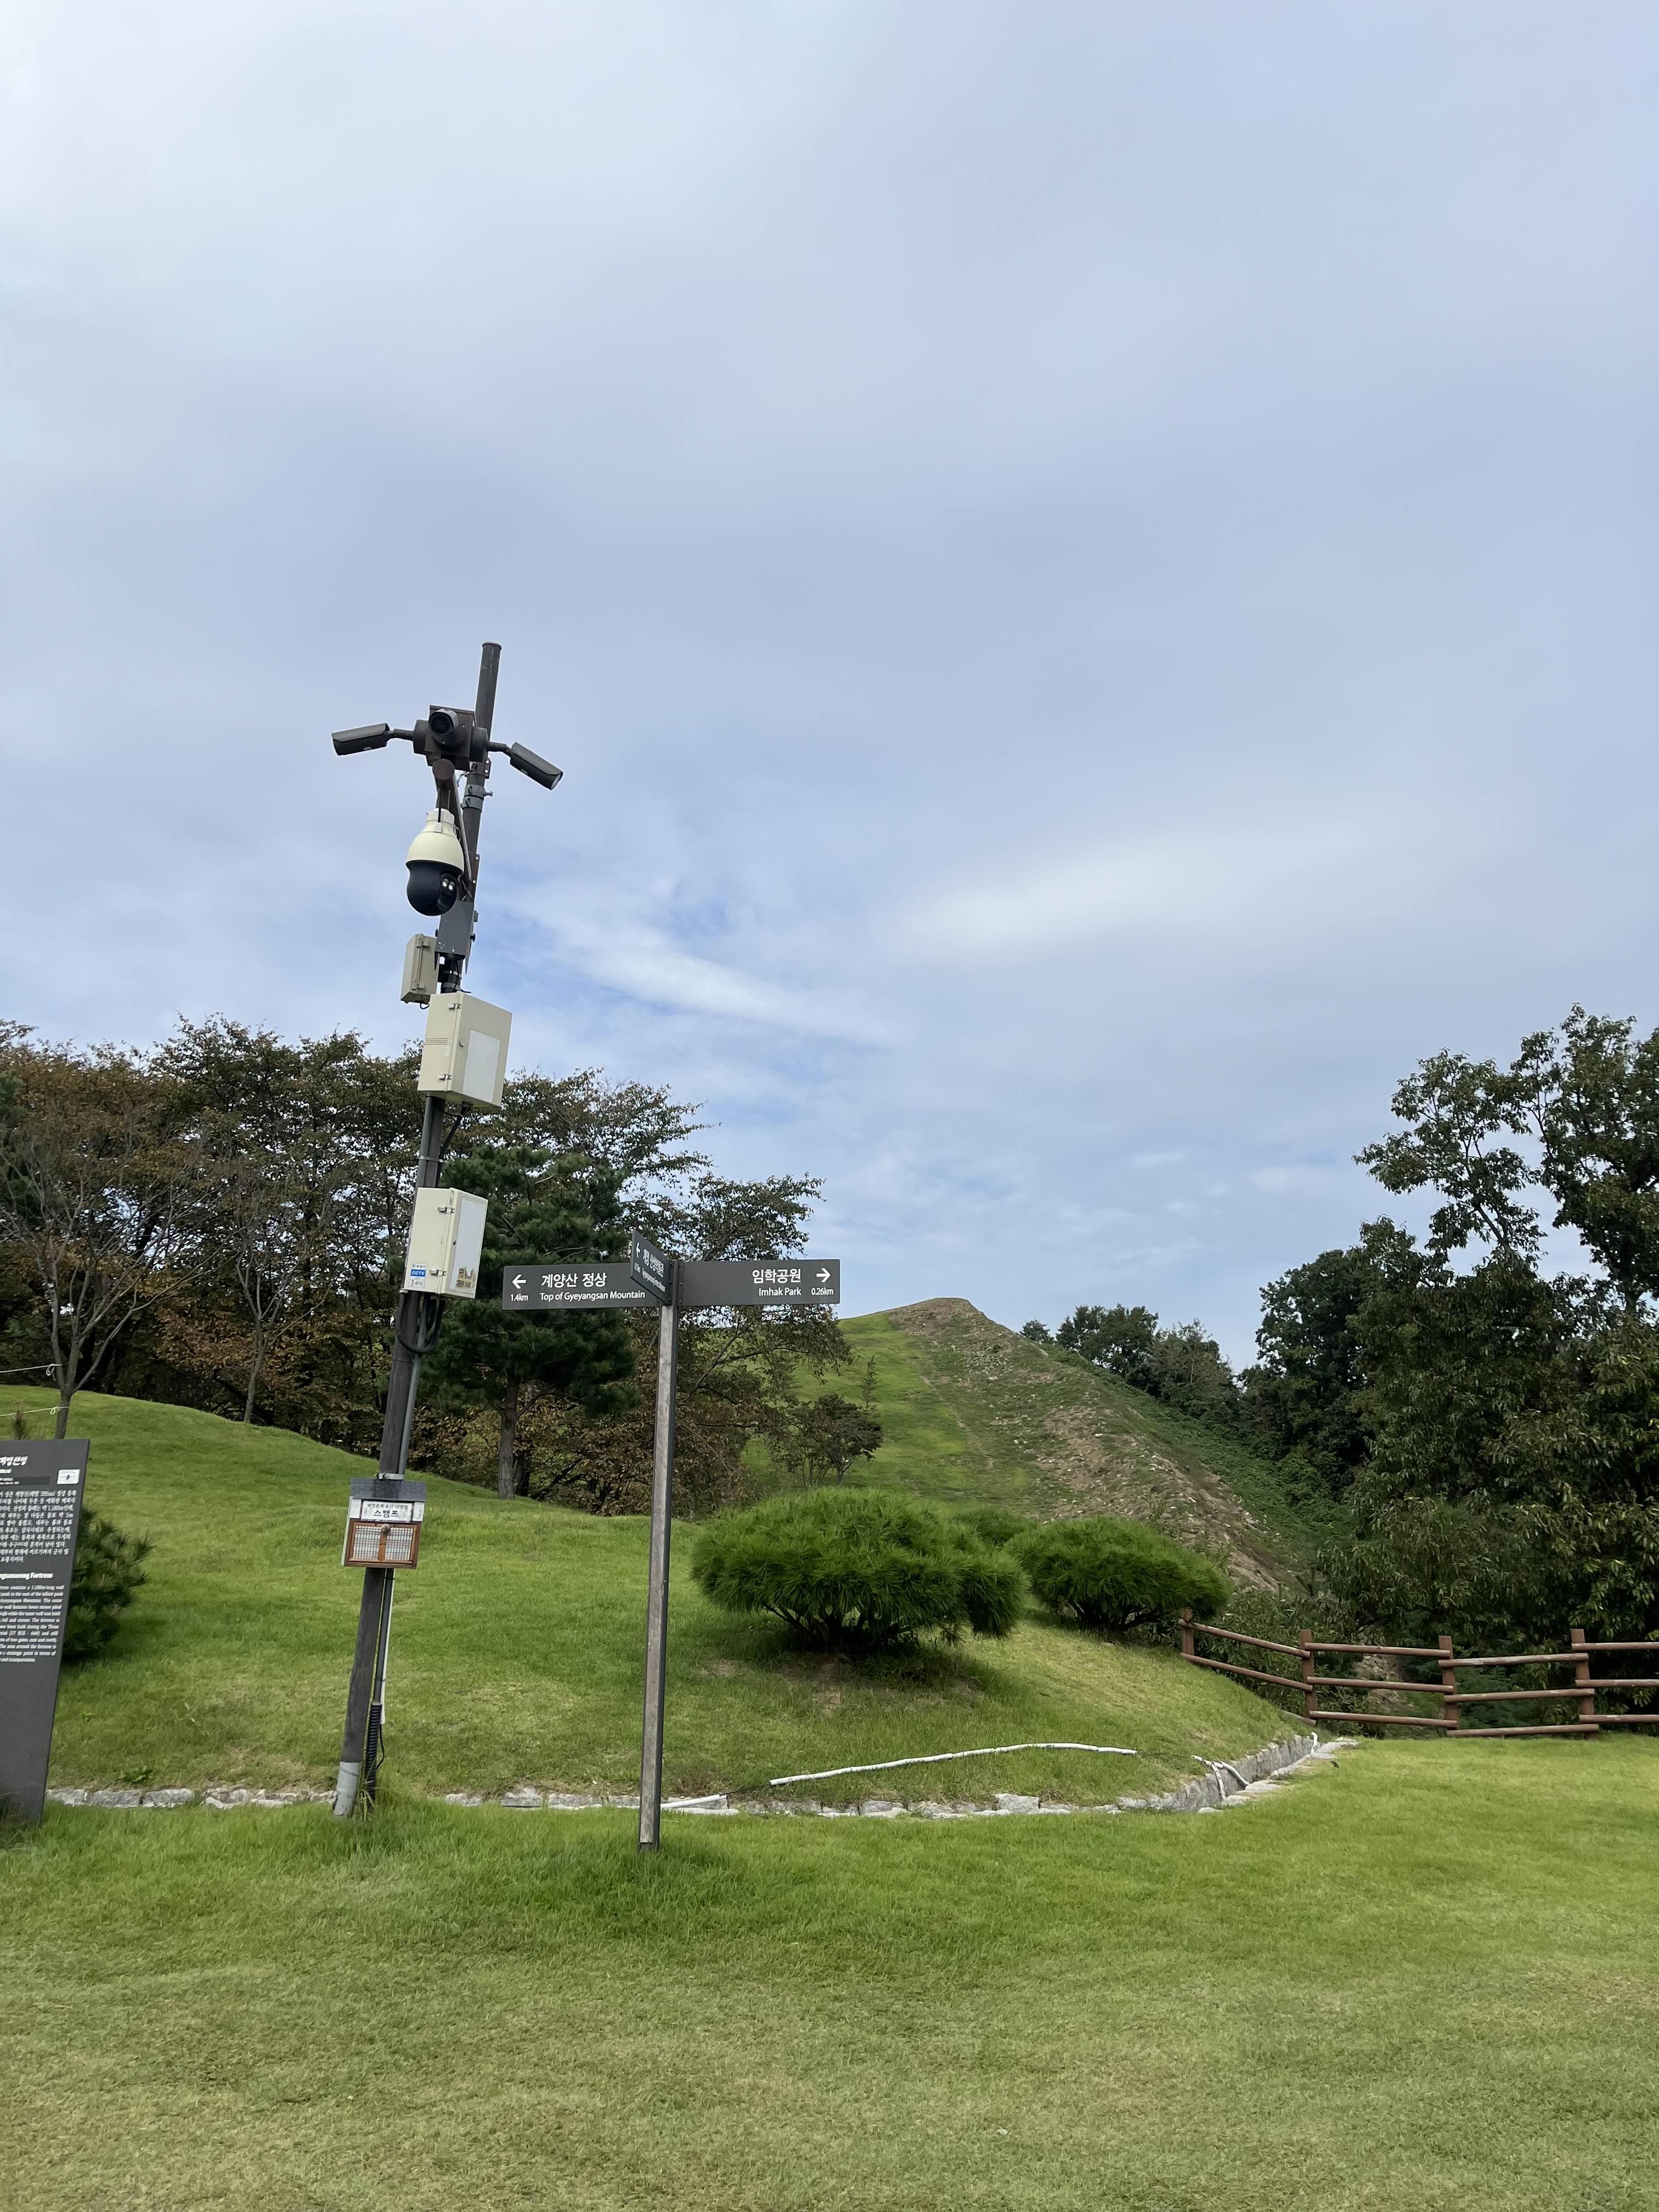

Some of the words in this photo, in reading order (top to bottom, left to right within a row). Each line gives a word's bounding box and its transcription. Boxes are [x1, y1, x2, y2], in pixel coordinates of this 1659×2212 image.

[541, 1273, 578, 1288] 계양산
[582, 1272, 607, 1287] 정상
[752, 1268, 801, 1284] 임학공원
[540, 1293, 554, 1302] Top
[555, 1291, 563, 1300] of
[564, 1291, 608, 1301] Gyeyangsan
[610, 1290, 645, 1299] Mountain
[759, 1287, 783, 1296] Imhak
[785, 1286, 802, 1295] Park
[811, 1287, 834, 1295] 0.26km
[510, 1293, 529, 1301] 1.4km
[373, 1509, 399, 1518] 스탬프
